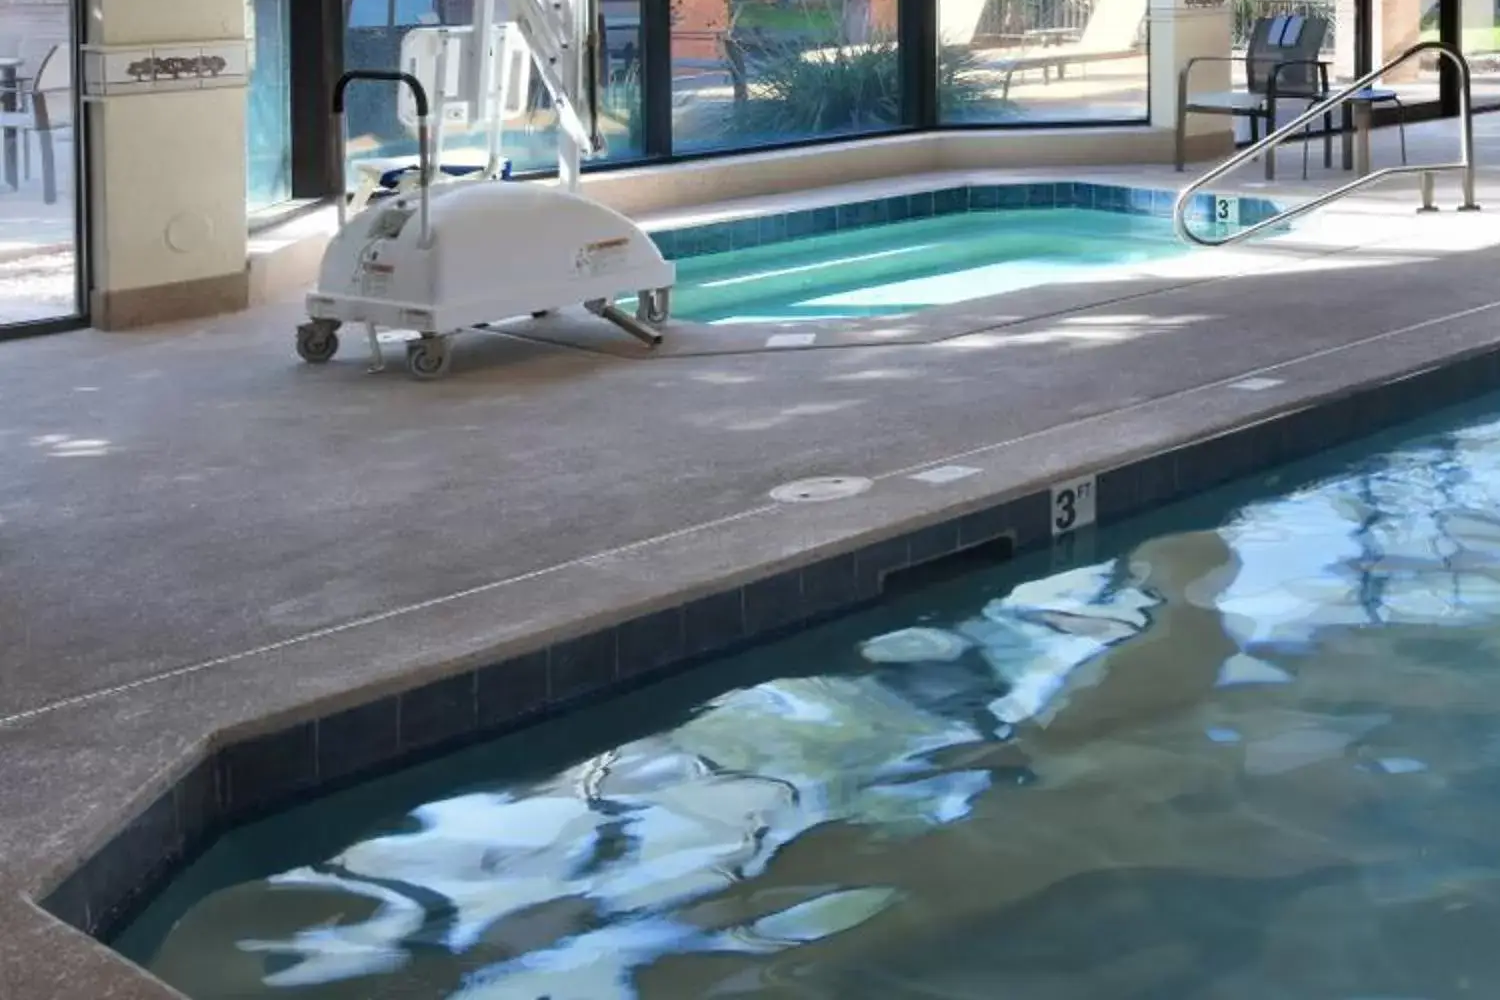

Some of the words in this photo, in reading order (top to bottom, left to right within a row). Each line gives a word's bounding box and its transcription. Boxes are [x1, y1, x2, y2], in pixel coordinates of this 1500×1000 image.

[1217, 199, 1229, 219] 3
[1056, 488, 1076, 529] 3
[1077, 482, 1091, 499] FT
